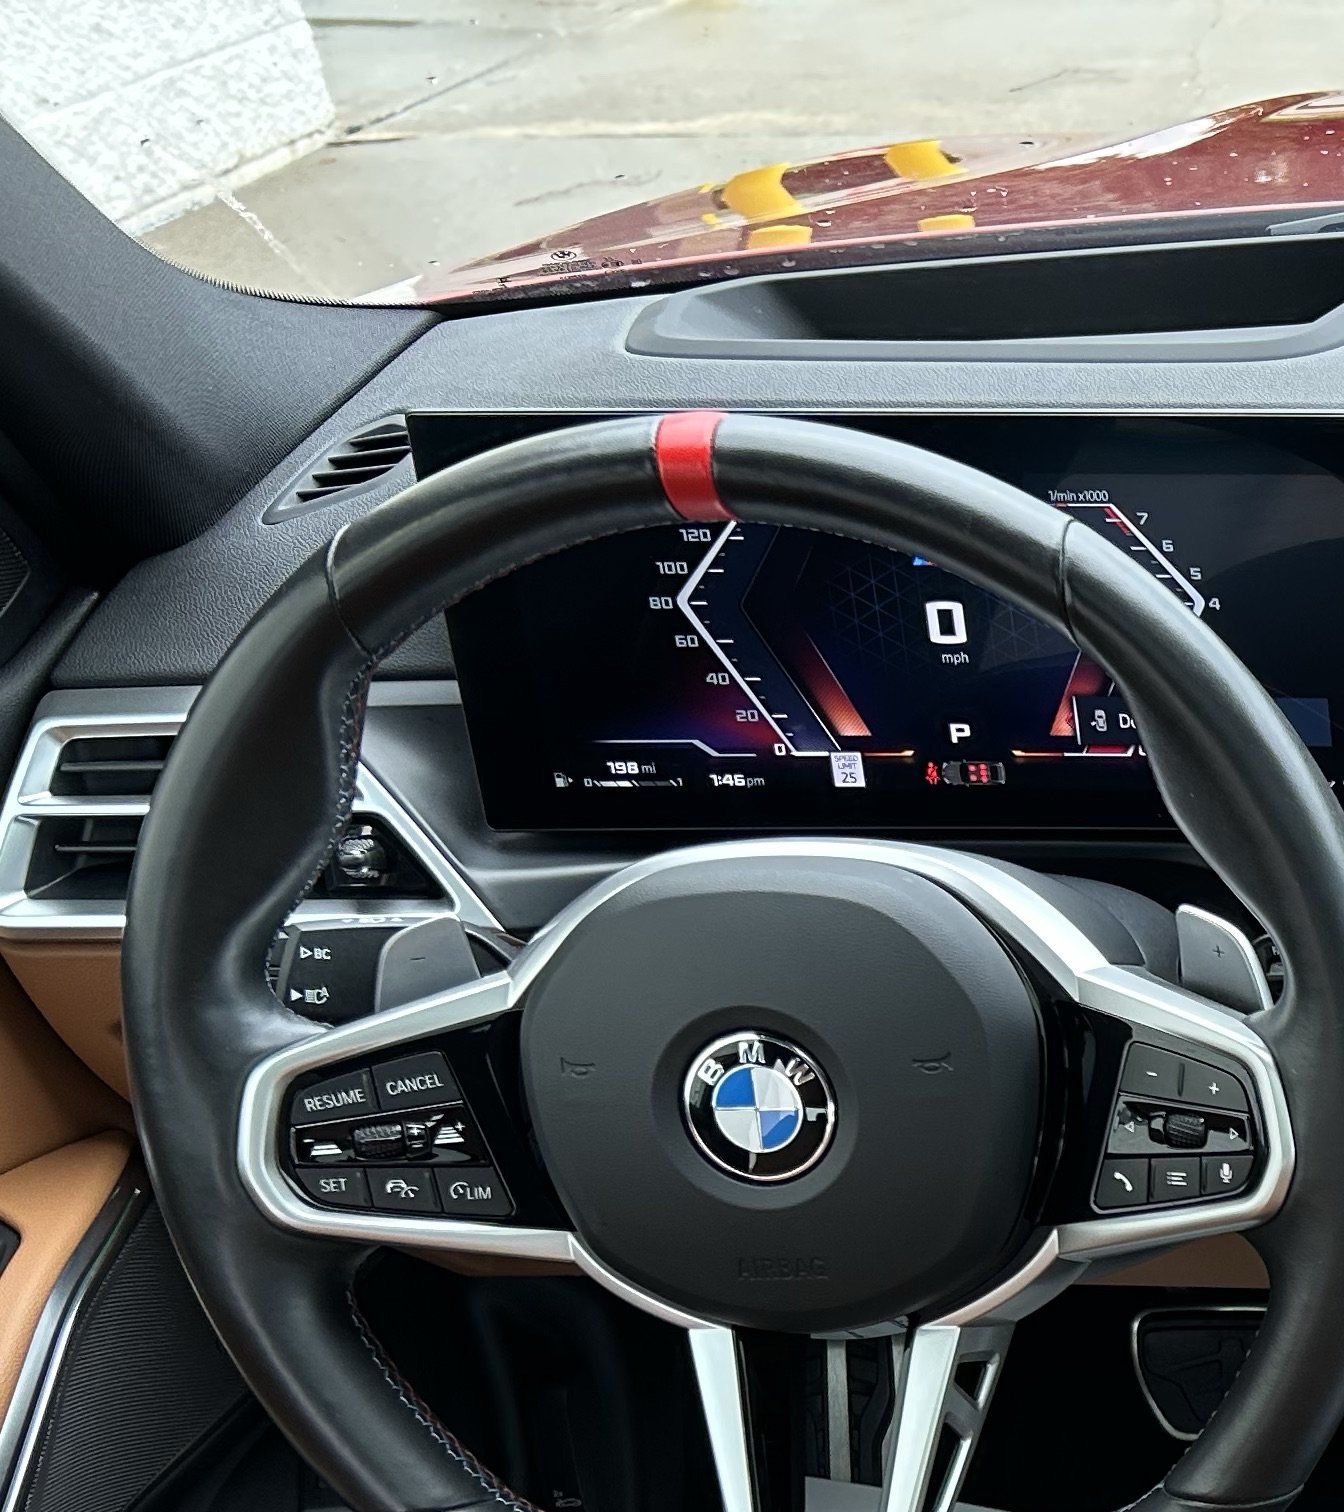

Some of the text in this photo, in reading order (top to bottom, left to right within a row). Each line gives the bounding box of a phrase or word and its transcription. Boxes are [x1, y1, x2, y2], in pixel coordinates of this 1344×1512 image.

[1078, 490, 1109, 502] x1000
[1136, 512, 1148, 525] 7
[679, 529, 711, 542] 120
[1162, 540, 1174, 552] 6
[655, 562, 688, 575] 100
[1190, 568, 1202, 580] 5
[649, 597, 673, 609] 80
[1208, 598, 1220, 610] 4
[925, 601, 967, 644] 0
[675, 635, 699, 648] 60
[942, 652, 969, 665] mph
[706, 672, 729, 685] 40
[736, 710, 759, 722] 20
[949, 724, 971, 743] P
[774, 744, 786, 756] 0
[606, 761, 656, 774] 198 mi
[841, 772, 857, 783] 25
[314, 948, 331, 960] BC
[697, 1041, 816, 1086] BMW
[386, 1073, 444, 1096] CANCEL
[304, 1088, 366, 1112] RESUME
[319, 1177, 348, 1194] SET
[466, 1186, 491, 1200] LIM
